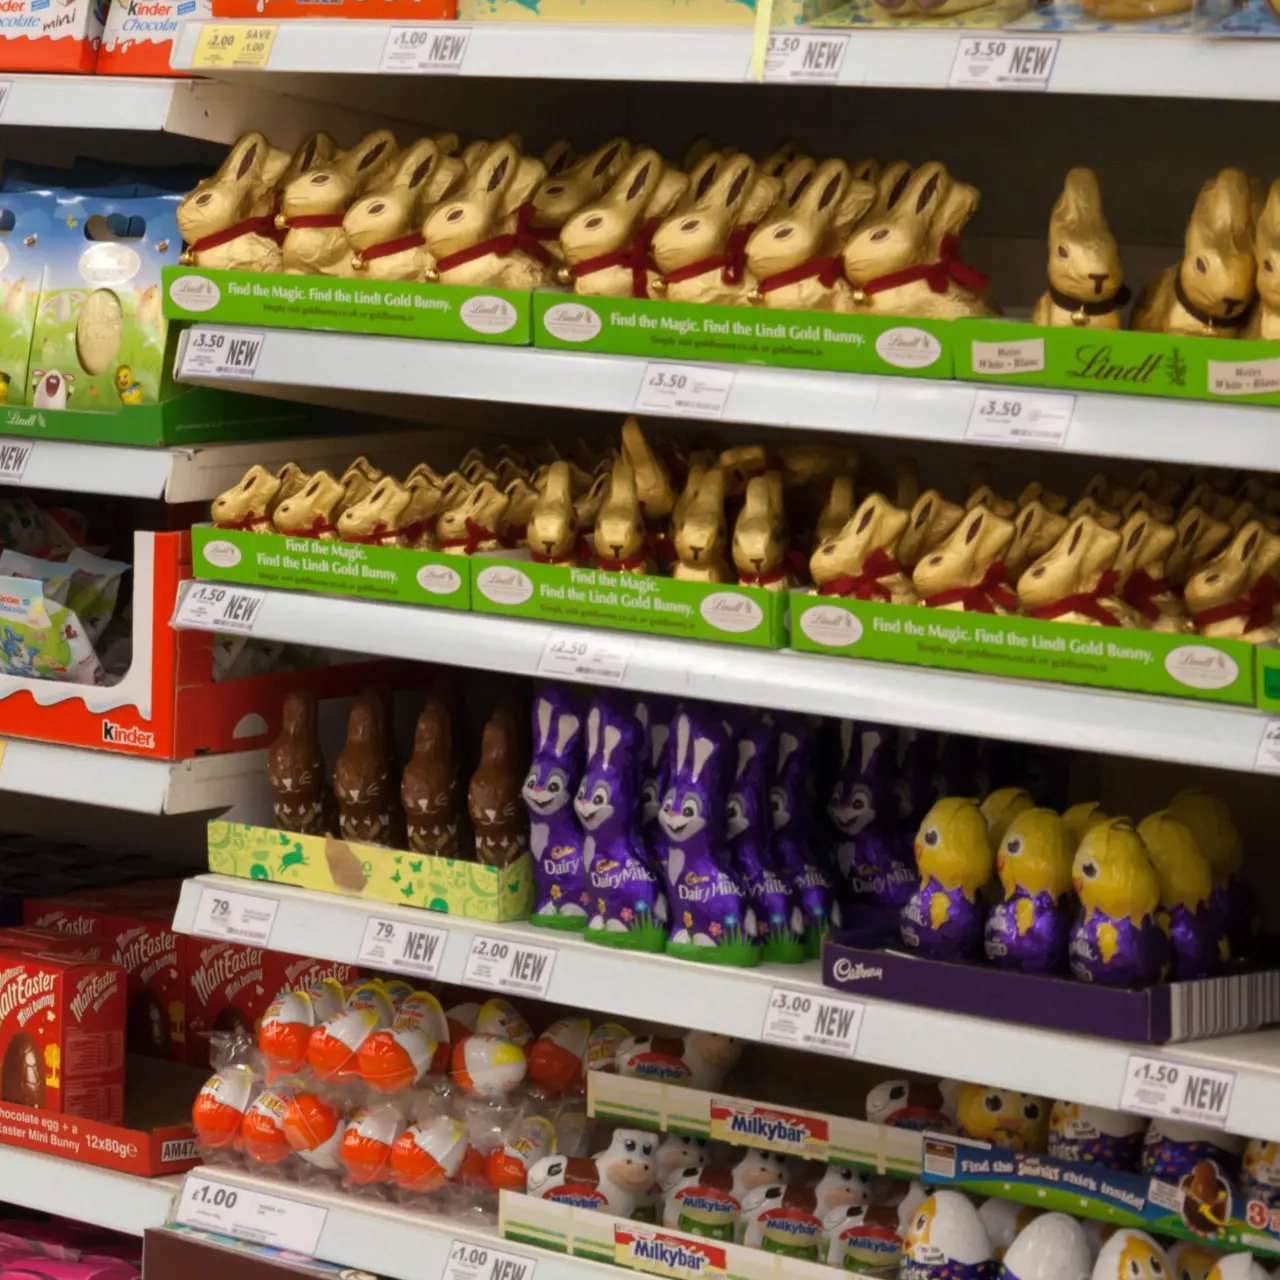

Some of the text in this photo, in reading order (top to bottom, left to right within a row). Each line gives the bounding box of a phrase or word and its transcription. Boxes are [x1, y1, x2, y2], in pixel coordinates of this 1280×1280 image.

[42, 10, 76, 31] mini
[245, 30, 272, 42] SAVE
[429, 34, 465, 60] NEW
[1010, 46, 1049, 73] NEW
[228, 282, 451, 311] Find the Magic. Find the Lindt Gold Bunny.
[226, 338, 258, 367] NEW
[1067, 344, 1161, 383] Lindt
[102, 720, 154, 747] Kinder
[404, 934, 438, 962] NEW
[832, 958, 883, 982] Cadbury
[814, 1005, 855, 1037] NEW
[41, 1115, 59, 1131] egg
[72, 1126, 78, 1134] a
[28, 1131, 46, 1145] Mini
[50, 1135, 80, 1152] Bunny
[191, 1186, 238, 1209] £1.00
[633, 1241, 705, 1270] Milkybar
